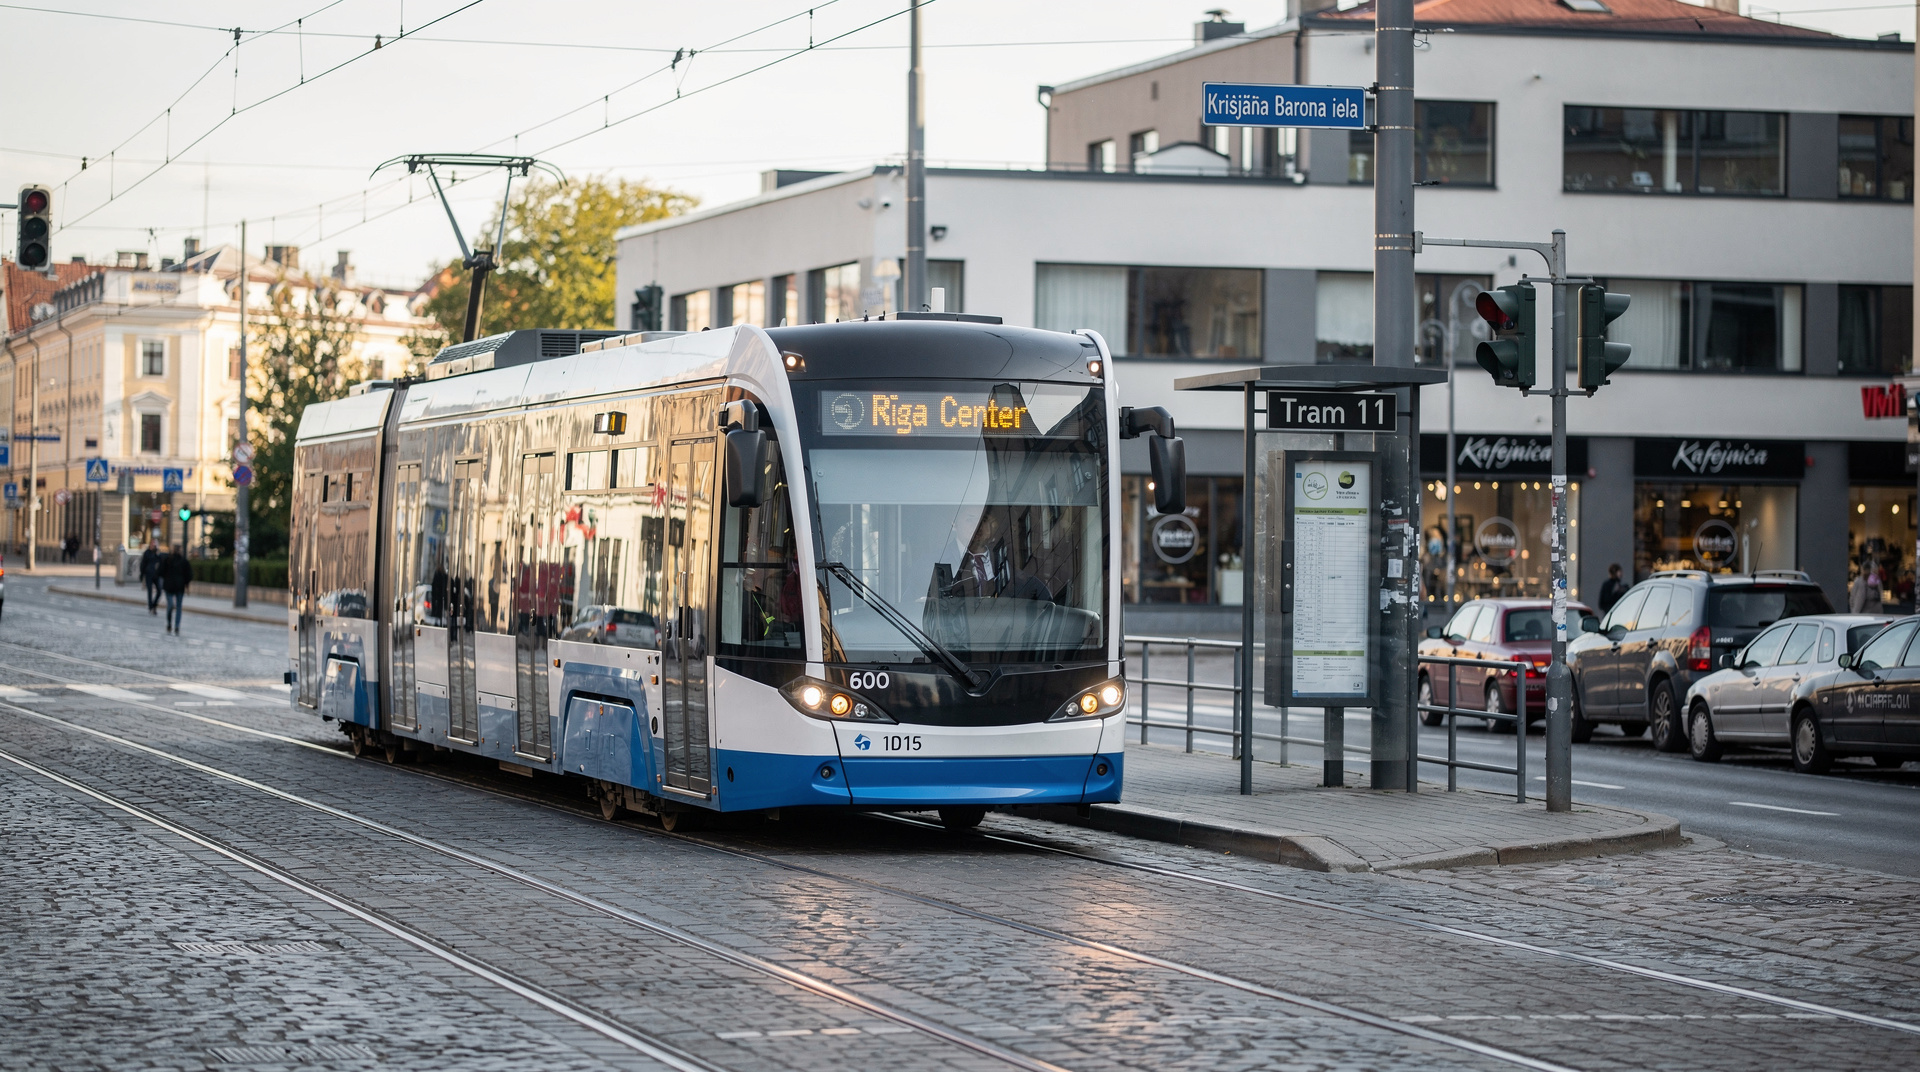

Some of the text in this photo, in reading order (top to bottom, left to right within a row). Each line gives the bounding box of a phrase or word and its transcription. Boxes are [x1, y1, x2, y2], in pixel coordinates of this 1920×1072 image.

[1275, 95, 1327, 118] Barona
[1333, 98, 1358, 118] iela
[941, 395, 1028, 428] Center
[1280, 397, 1384, 425] Tram 11
[849, 671, 890, 690] 600
